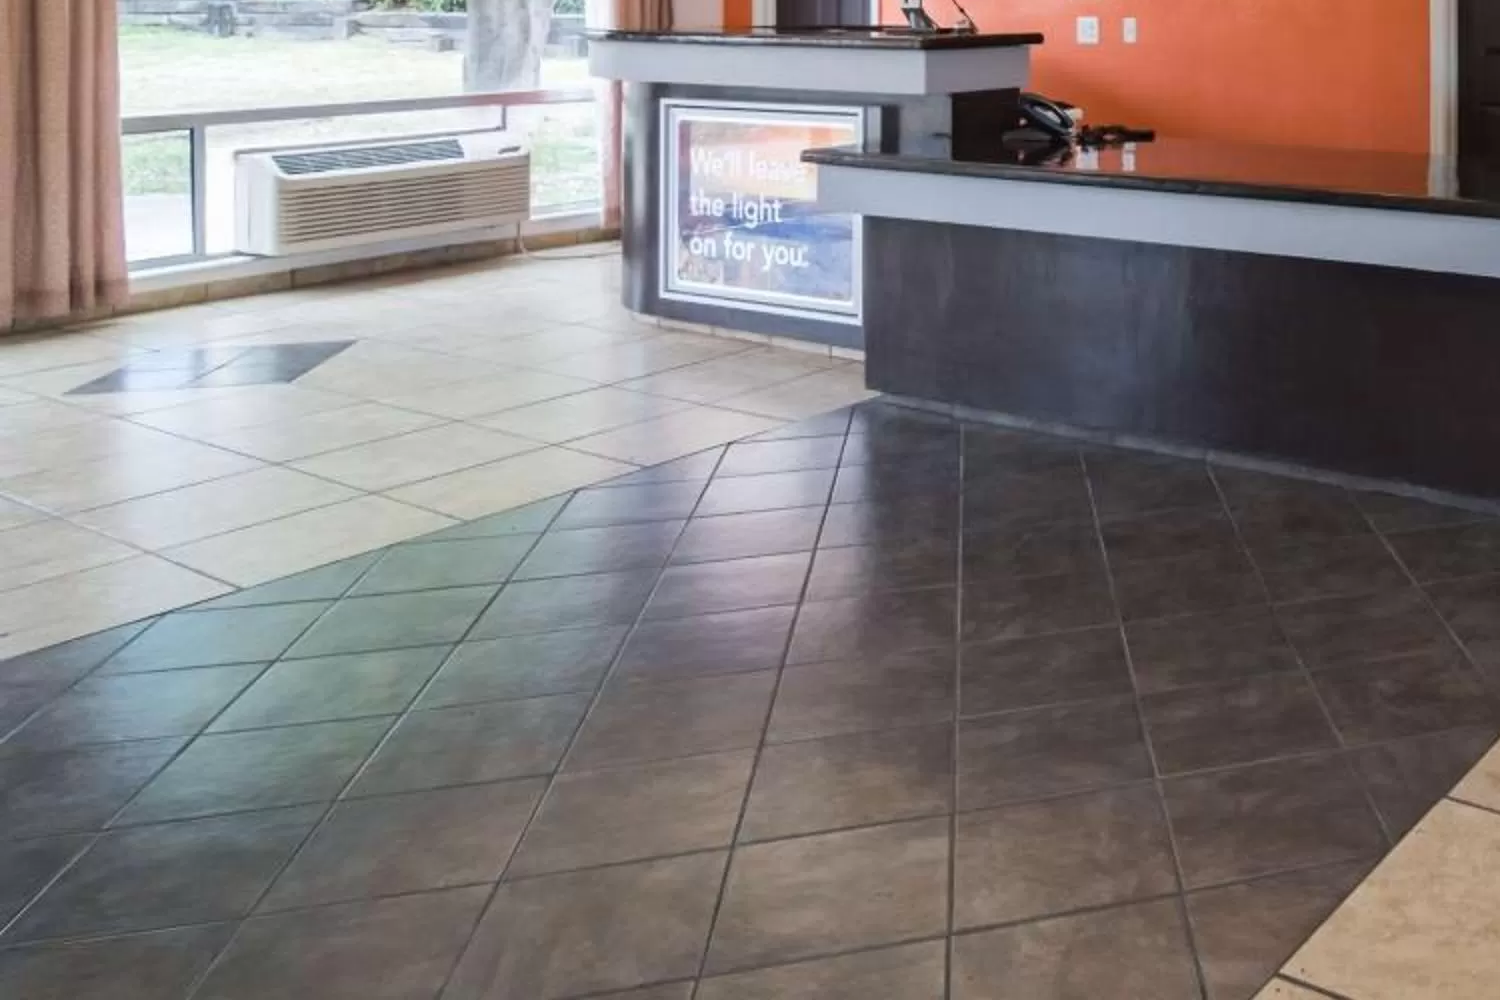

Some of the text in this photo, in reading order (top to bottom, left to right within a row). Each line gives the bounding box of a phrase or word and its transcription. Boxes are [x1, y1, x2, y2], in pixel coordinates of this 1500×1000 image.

[690, 147, 742, 178] We'll
[690, 188, 784, 229] the light
[690, 235, 717, 258] on
[723, 231, 755, 263] for
